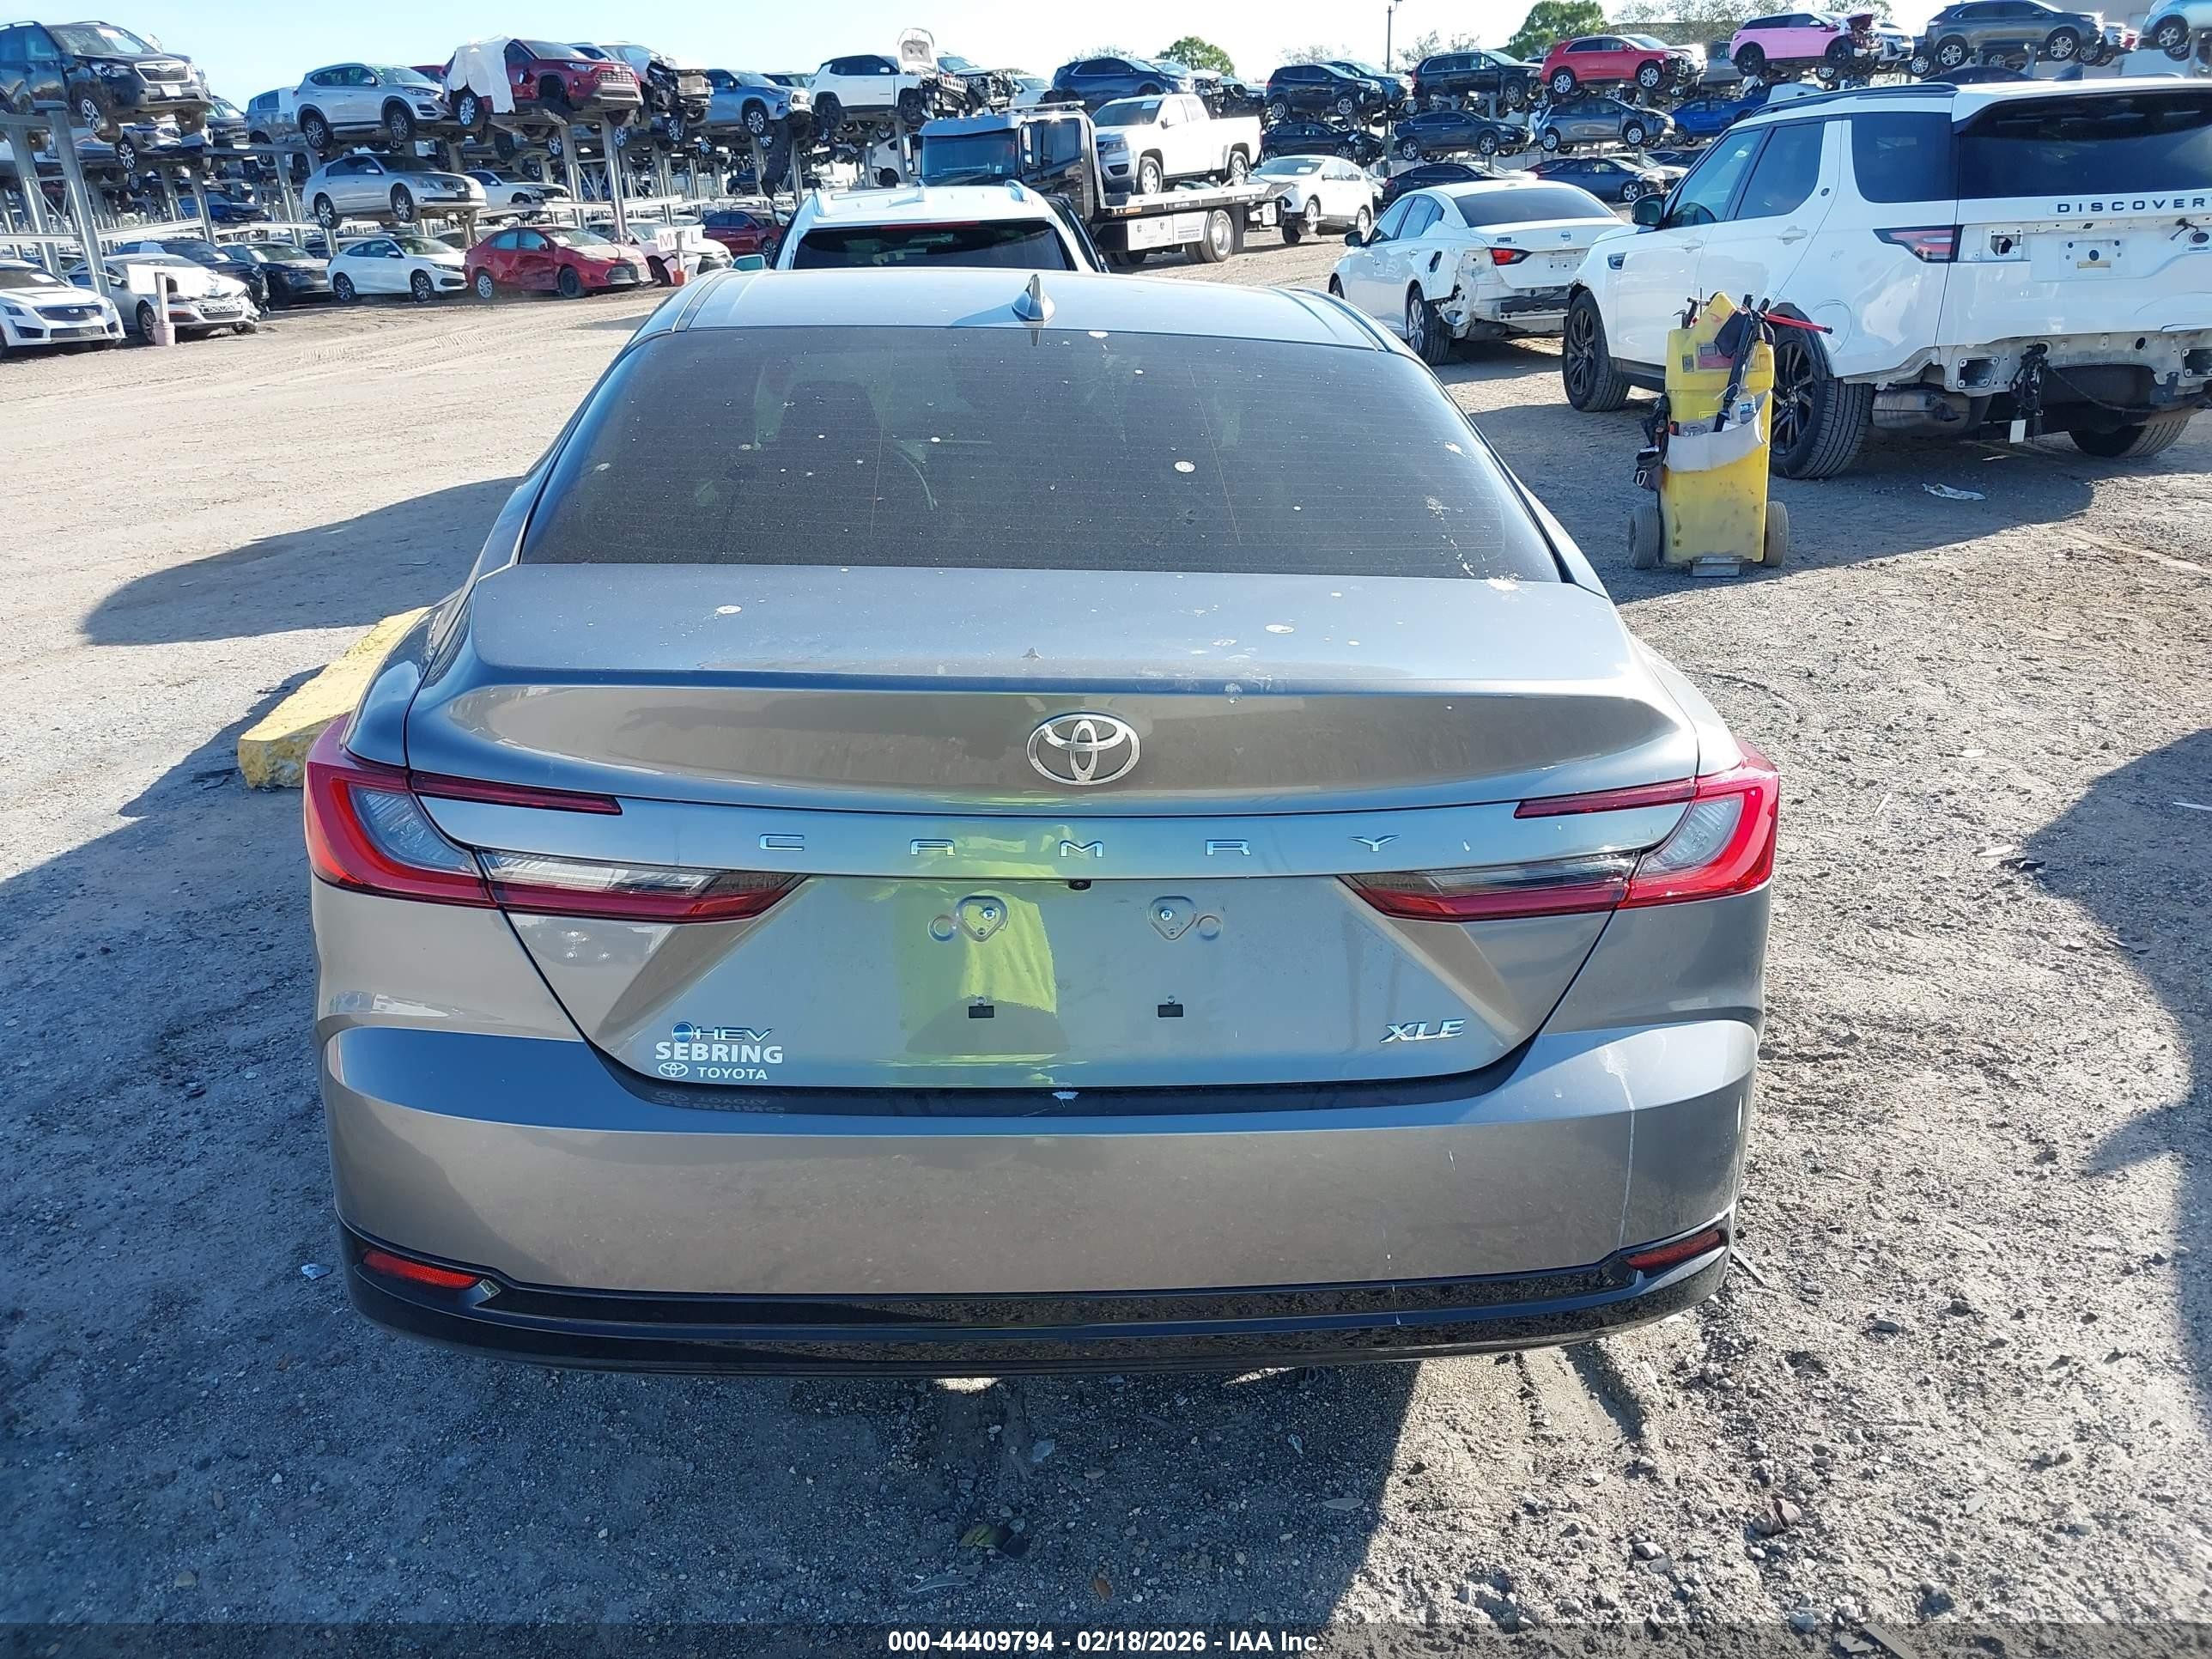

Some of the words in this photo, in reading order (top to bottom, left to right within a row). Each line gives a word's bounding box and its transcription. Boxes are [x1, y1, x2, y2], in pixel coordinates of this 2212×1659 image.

[2057, 197, 2212, 213] DISCOVER
[759, 833, 1401, 857] CAMRY
[694, 1026, 775, 1042] HEV
[1379, 1018, 1466, 1043] XLE
[655, 1042, 783, 1064] SEBRING
[696, 1066, 769, 1080] TOYOTA
